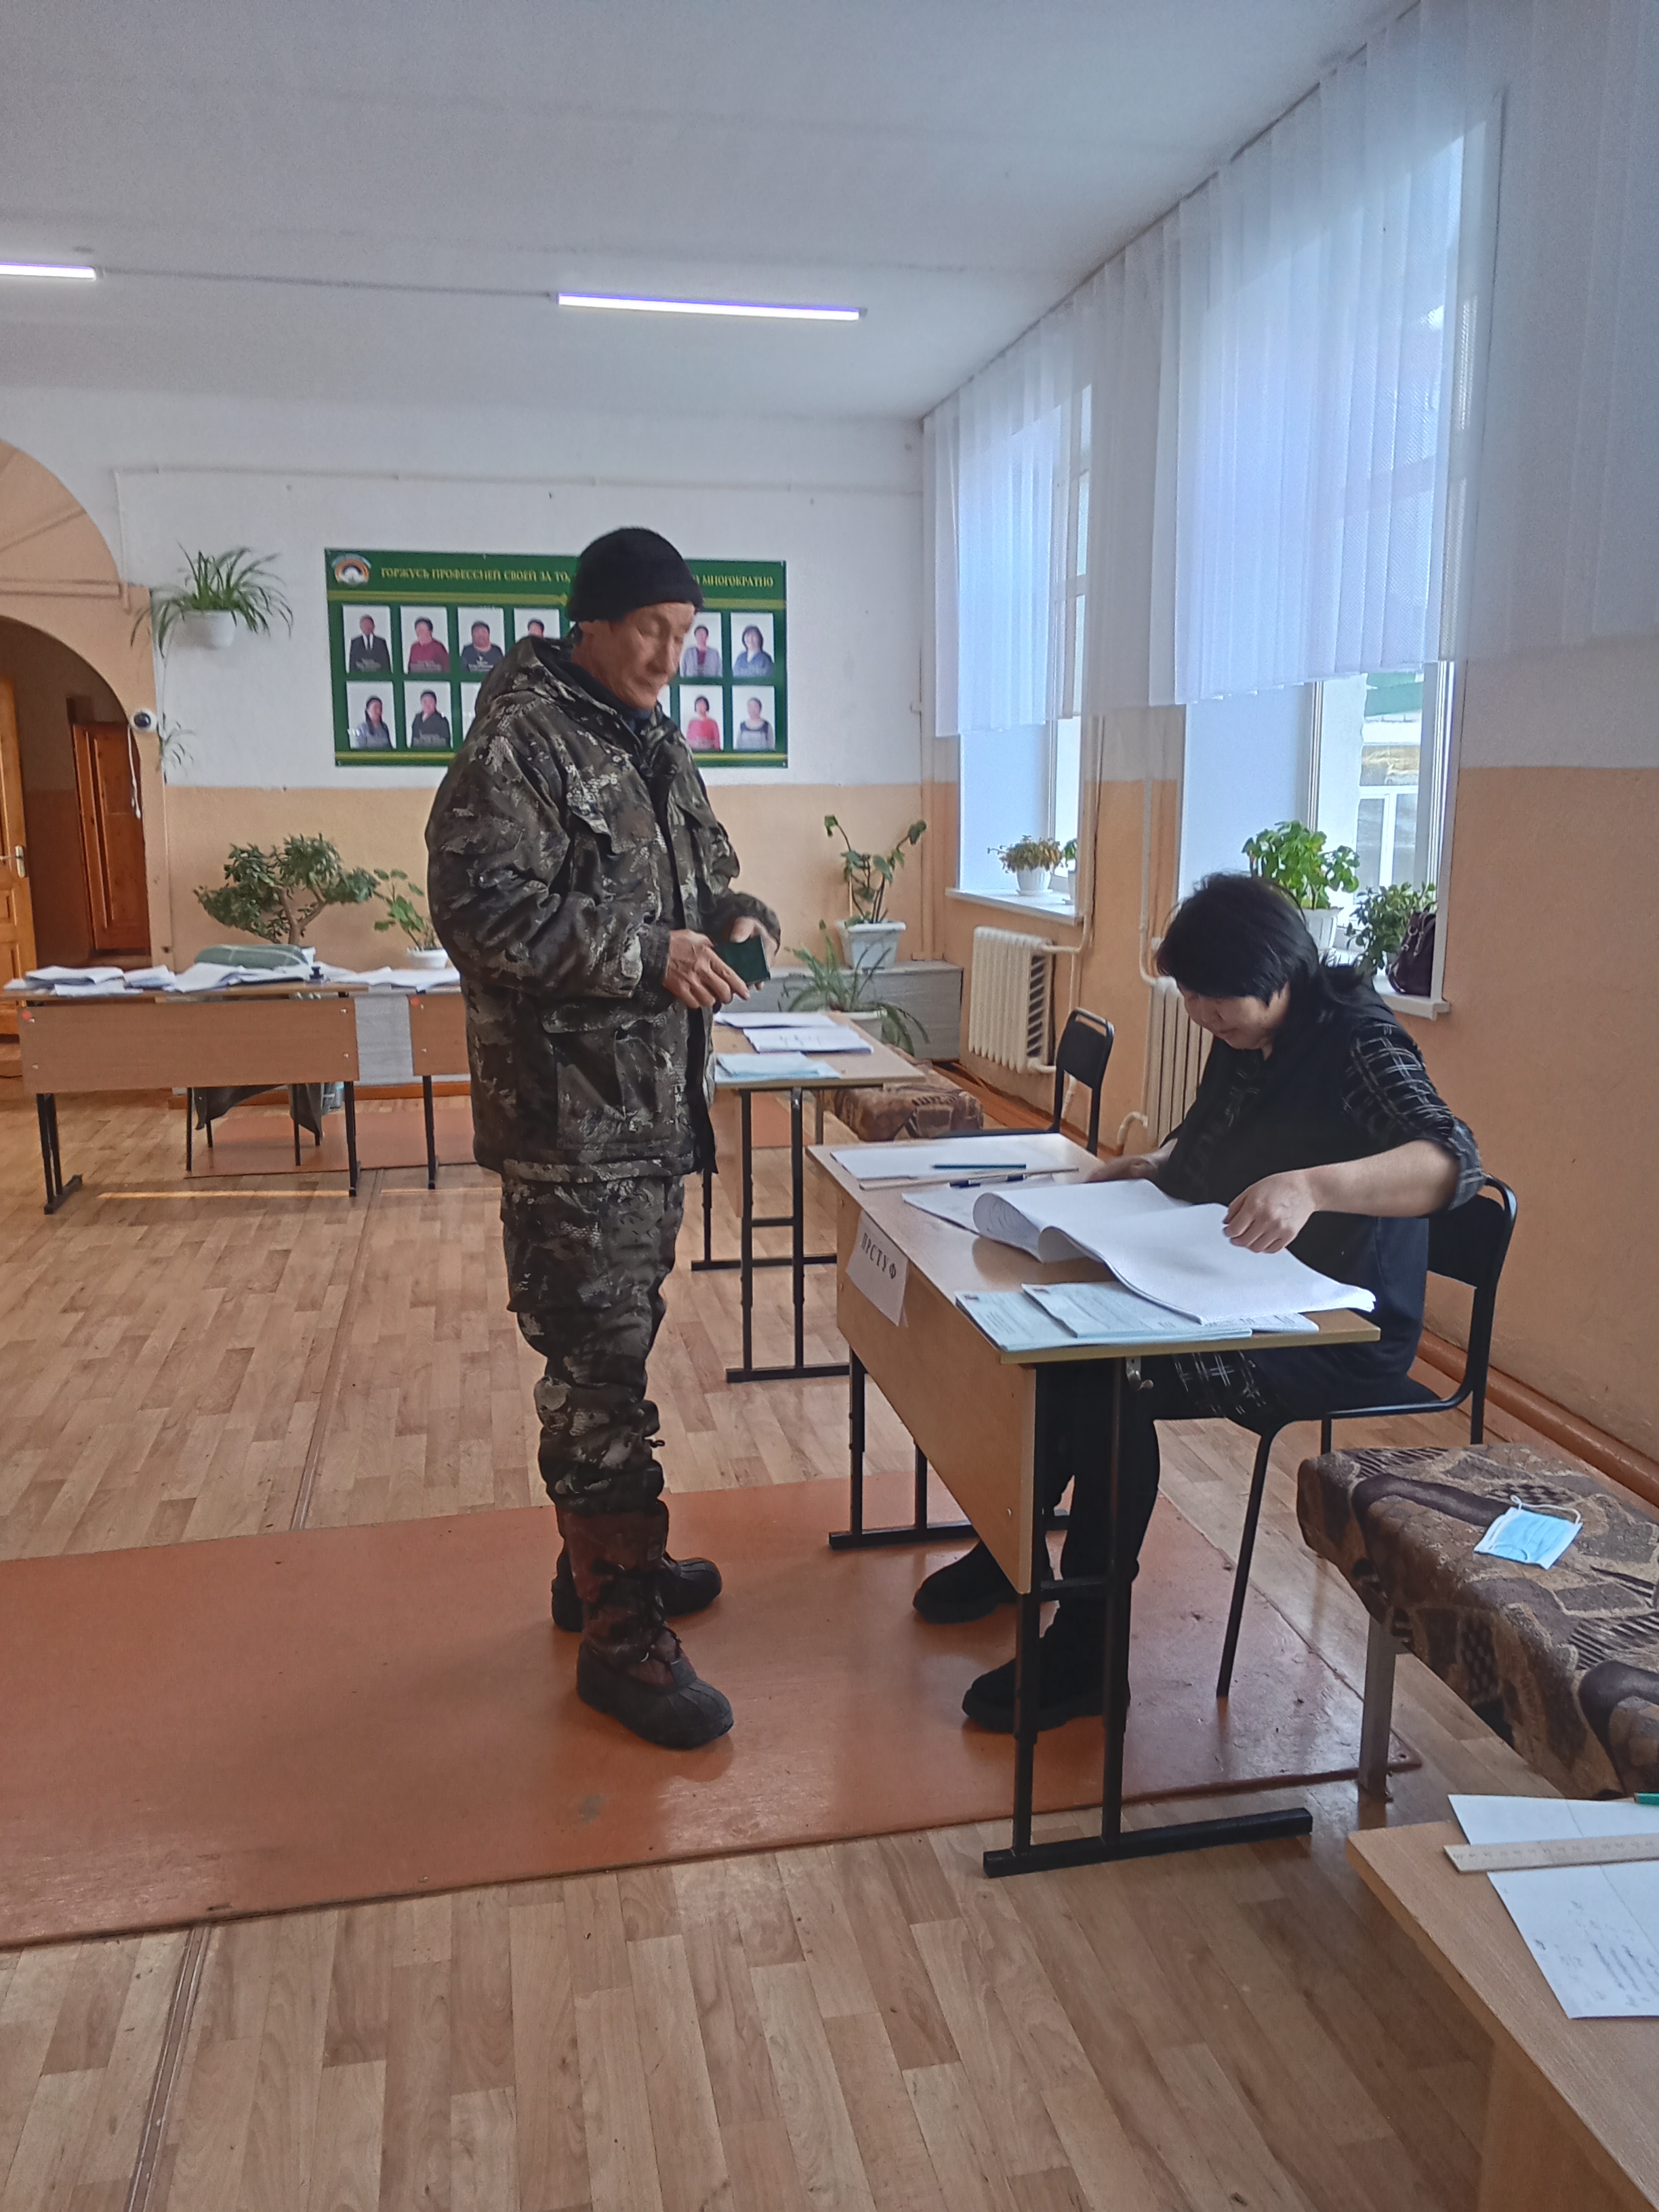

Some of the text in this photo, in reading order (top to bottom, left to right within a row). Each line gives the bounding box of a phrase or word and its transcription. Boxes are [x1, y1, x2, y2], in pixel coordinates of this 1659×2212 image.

[381, 567, 430, 579] ГОРЖУСЬ
[432, 568, 501, 581] ПРОФЕССИЕЙ
[504, 569, 537, 581] СВОЕЙ
[540, 571, 552, 581] ЗА
[702, 575, 774, 588] МНОГОКРАТНО
